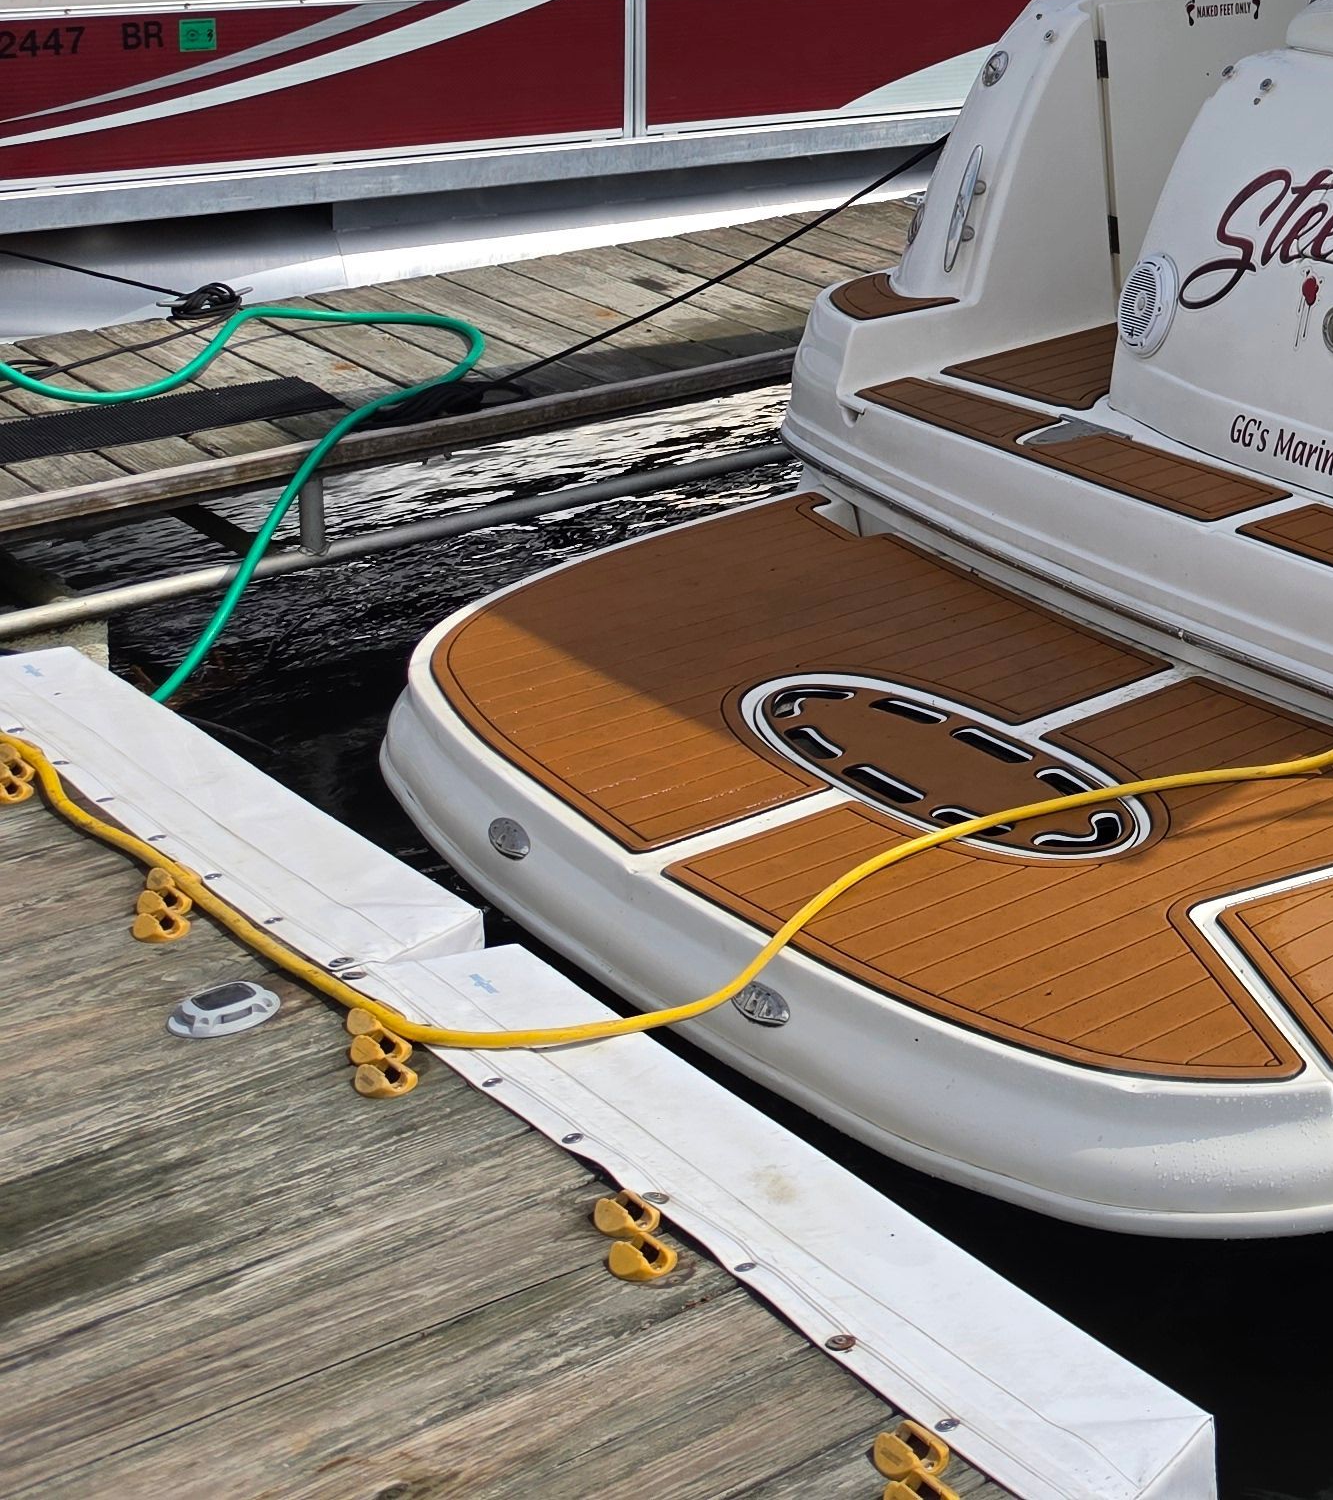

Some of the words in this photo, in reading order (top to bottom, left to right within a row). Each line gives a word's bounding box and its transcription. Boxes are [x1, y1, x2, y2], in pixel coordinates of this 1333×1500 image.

[1197, 4, 1219, 18] NAKED
[1220, 3, 1234, 16] FEET
[1235, 1, 1251, 15] ONLY
[0, 26, 85, 60] 2447
[121, 21, 164, 50] BR
[1230, 414, 1270, 452] GG's
